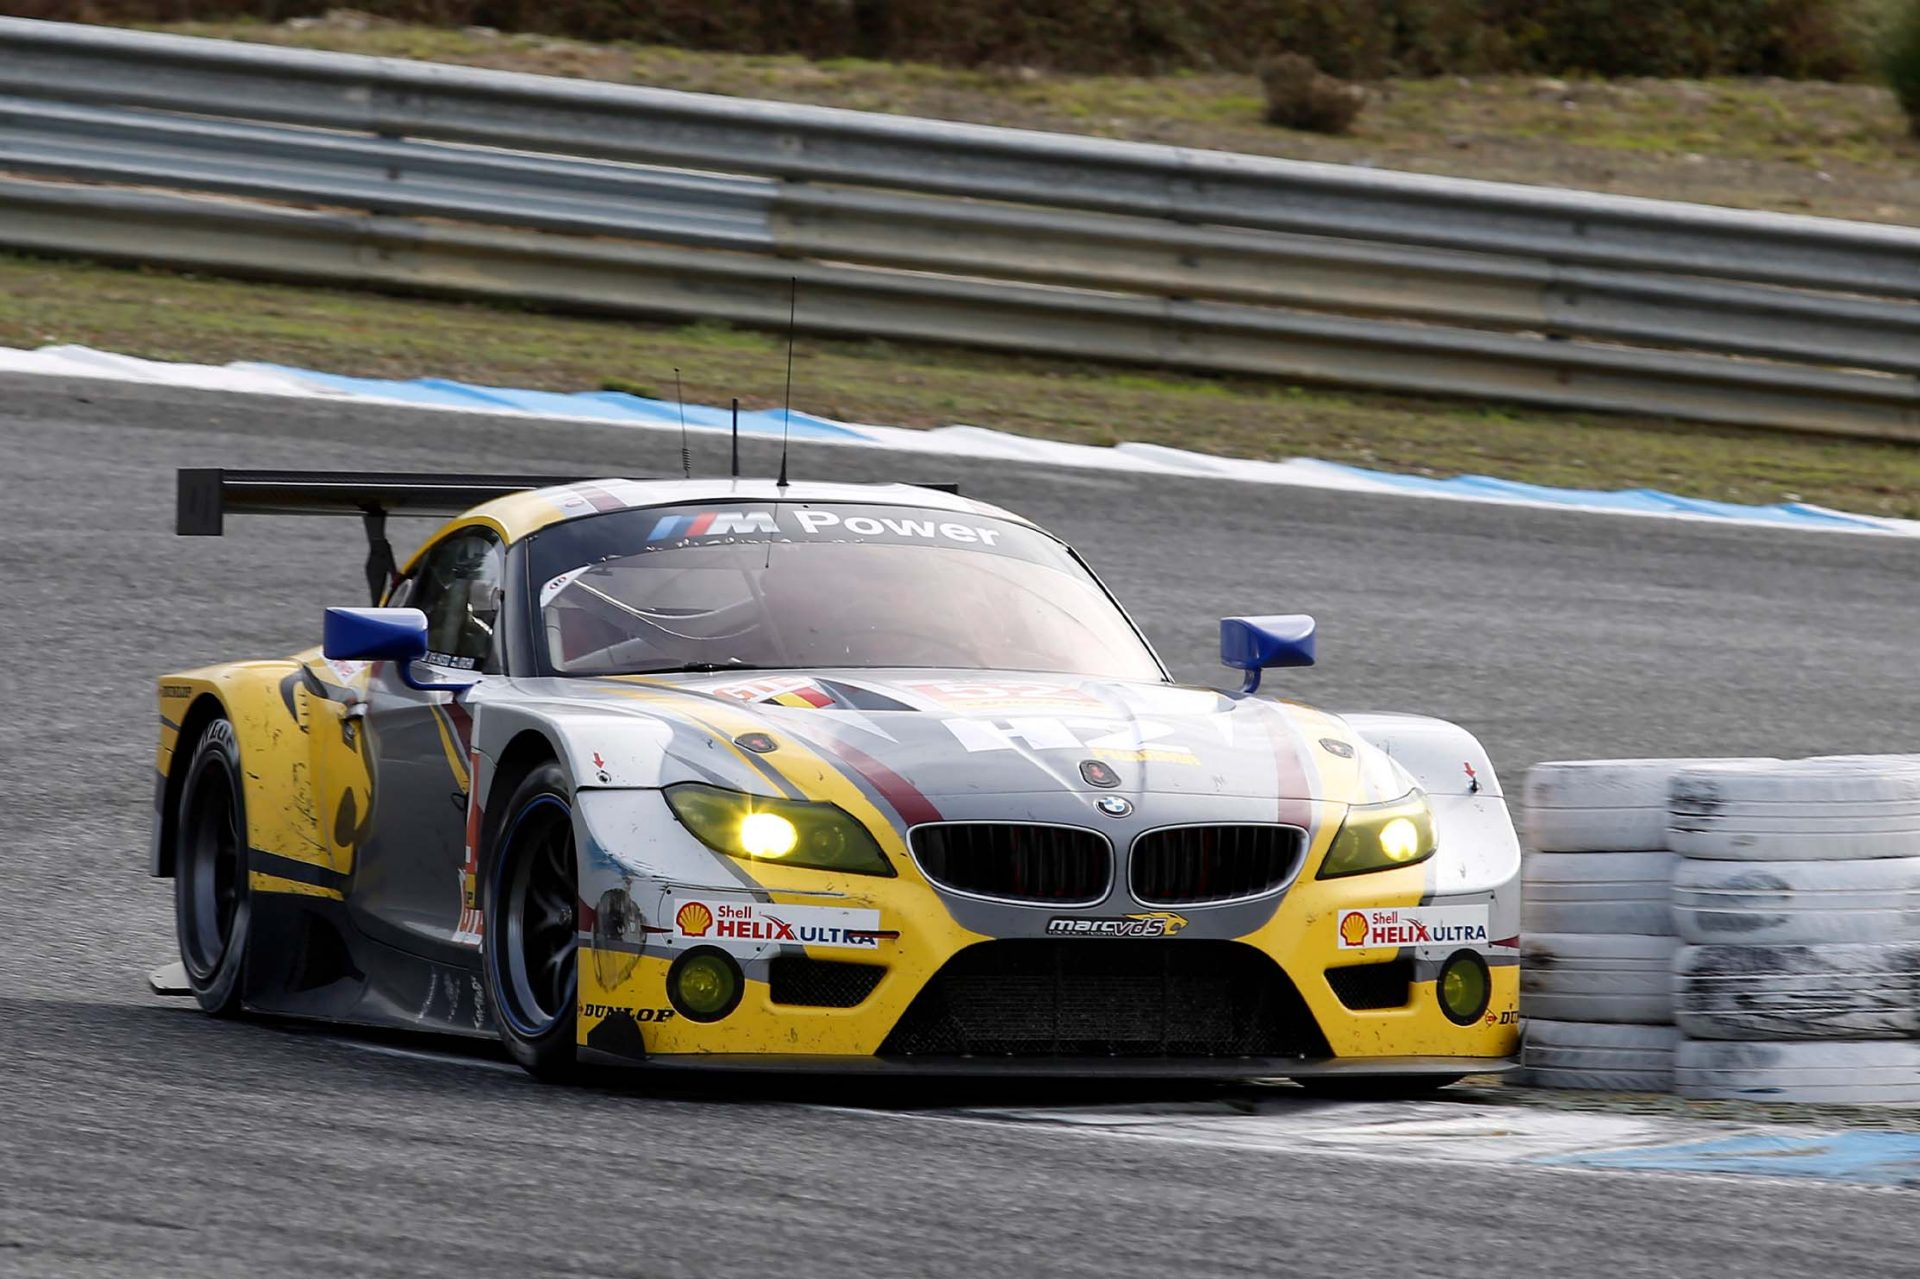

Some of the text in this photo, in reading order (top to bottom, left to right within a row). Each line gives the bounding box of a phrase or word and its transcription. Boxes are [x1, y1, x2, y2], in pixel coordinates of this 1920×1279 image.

[792, 510, 1001, 547] Power
[717, 905, 752, 919] Shell
[1372, 912, 1399, 925] Shell
[716, 920, 876, 946] HELIX ULTRA
[1372, 924, 1487, 944] HELIX ULTRA
